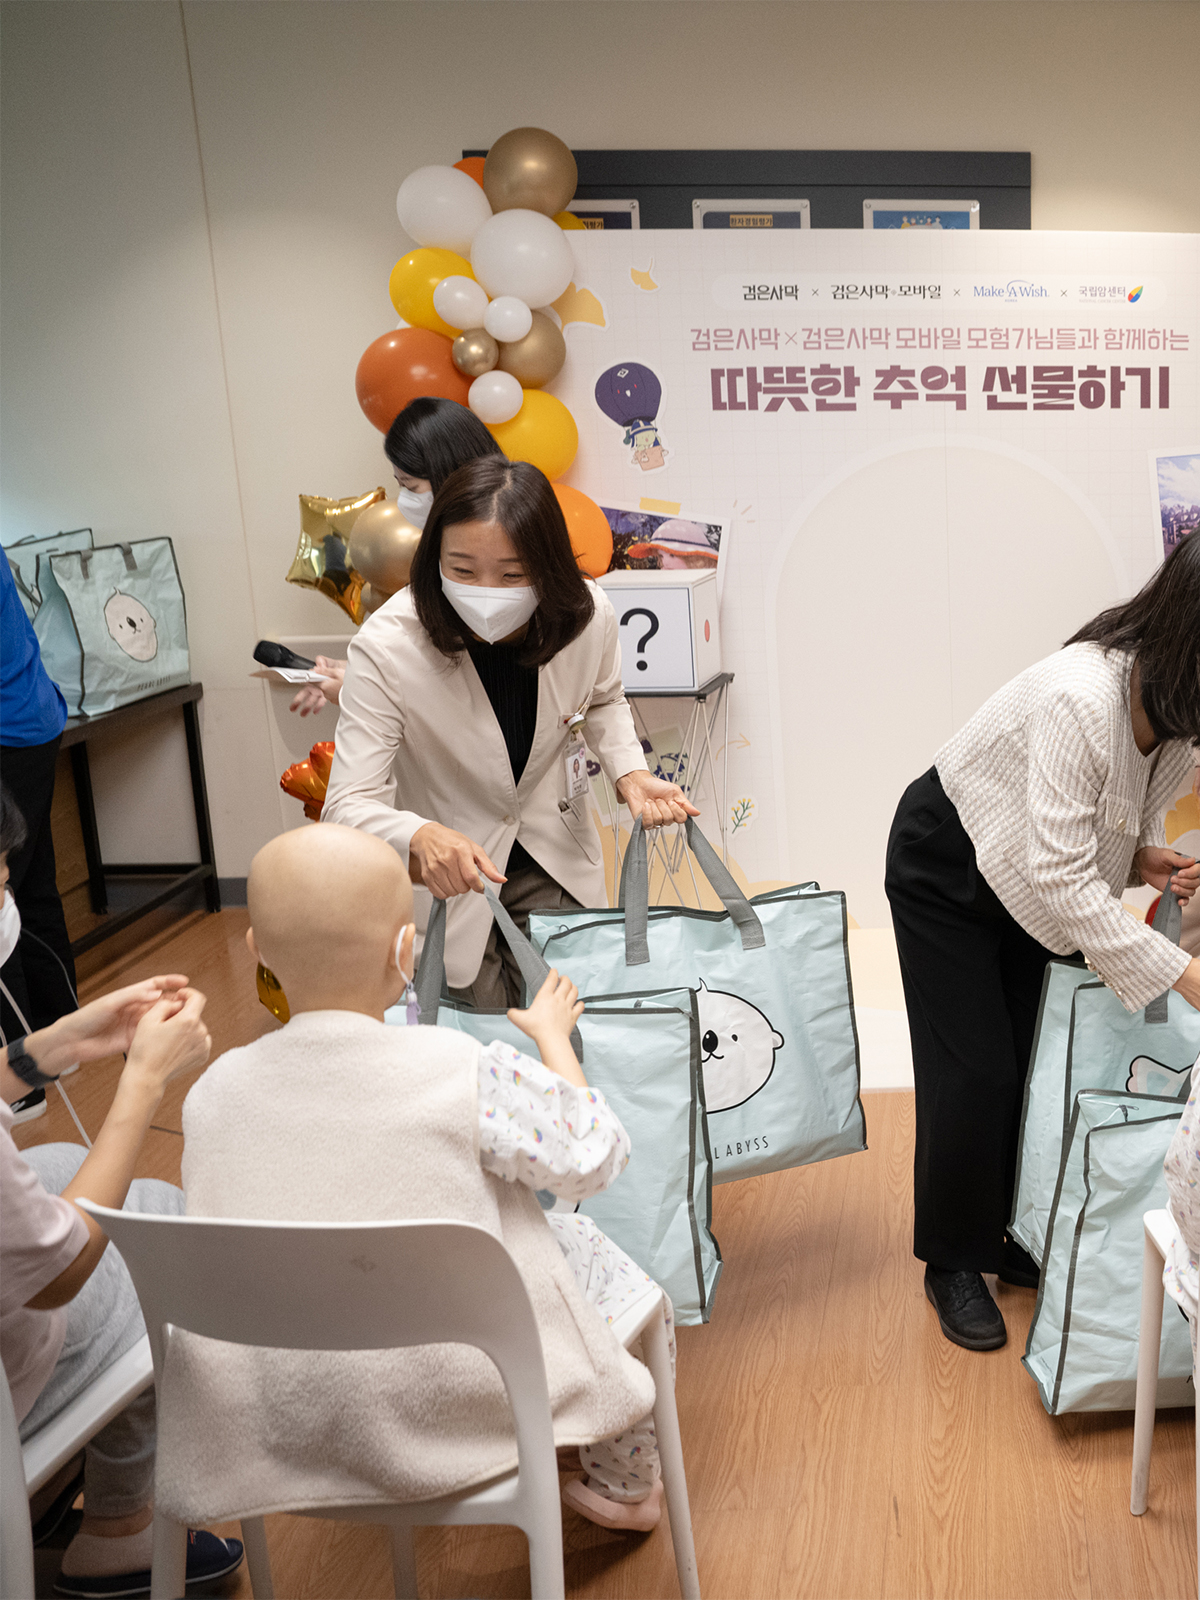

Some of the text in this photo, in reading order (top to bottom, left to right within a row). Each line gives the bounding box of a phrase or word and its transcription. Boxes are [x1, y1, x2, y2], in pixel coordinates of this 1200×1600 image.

[741, 284, 799, 301] 검은사막
[898, 284, 941, 300] 모바일
[973, 285, 1004, 298] Make
[1079, 286, 1126, 298] 국립암센터
[896, 328, 961, 350] 모바일
[967, 327, 1100, 350] 모험가님들과
[1104, 328, 1189, 351] 함께하는
[711, 364, 1169, 412] 따뜻한 추억 선물하기
[726, 1135, 769, 1157] ABYSS
